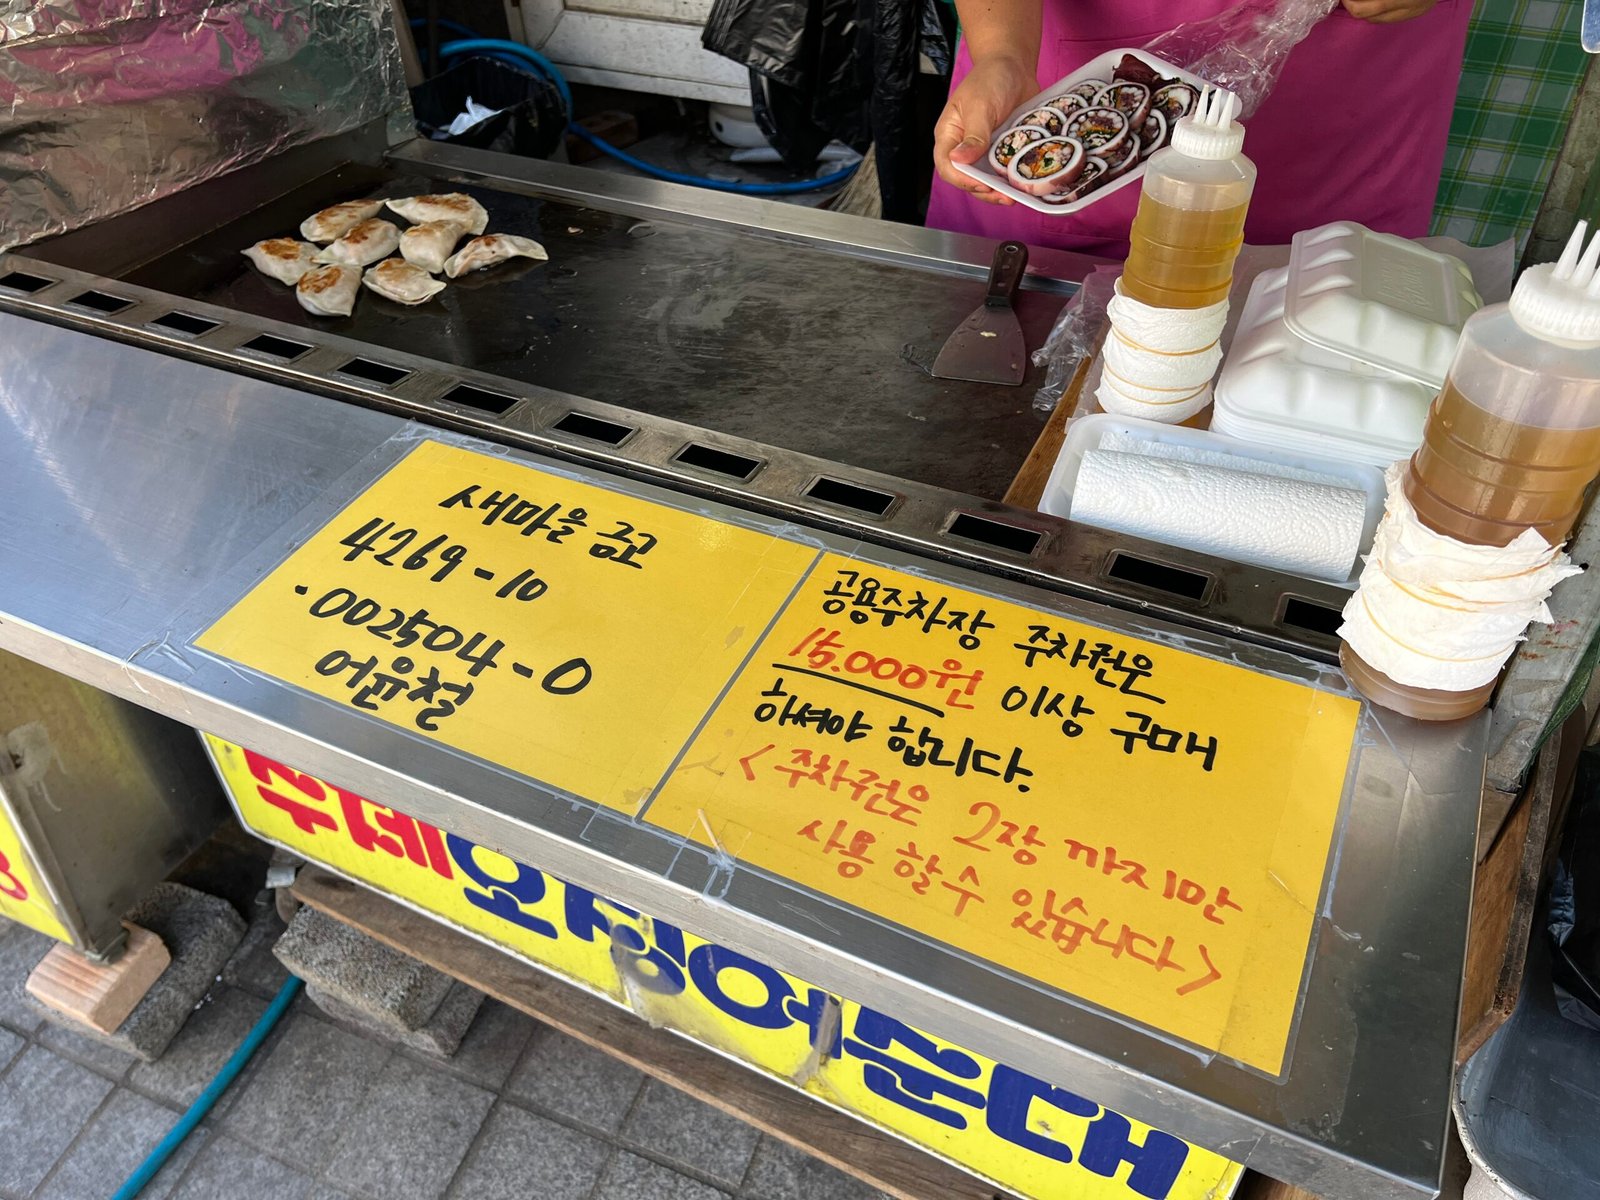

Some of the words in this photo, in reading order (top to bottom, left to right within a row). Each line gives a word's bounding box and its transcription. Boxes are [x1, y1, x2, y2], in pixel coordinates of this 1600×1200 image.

[340, 517, 548, 602] 4269-10
[439, 484, 588, 544] 새마을
[588, 521, 659, 570] 금고
[822, 570, 996, 651] 공용주차장
[1013, 624, 1167, 705] 주차권은
[314, 650, 475, 732] 어윤철
[1000, 685, 1095, 738] 이상
[1109, 711, 1218, 772] 구매
[753, 677, 873, 743] 하셔야
[887, 715, 1035, 793] 합니다.
[796, 819, 876, 879] 사용
[952, 801, 1047, 866] 2장
